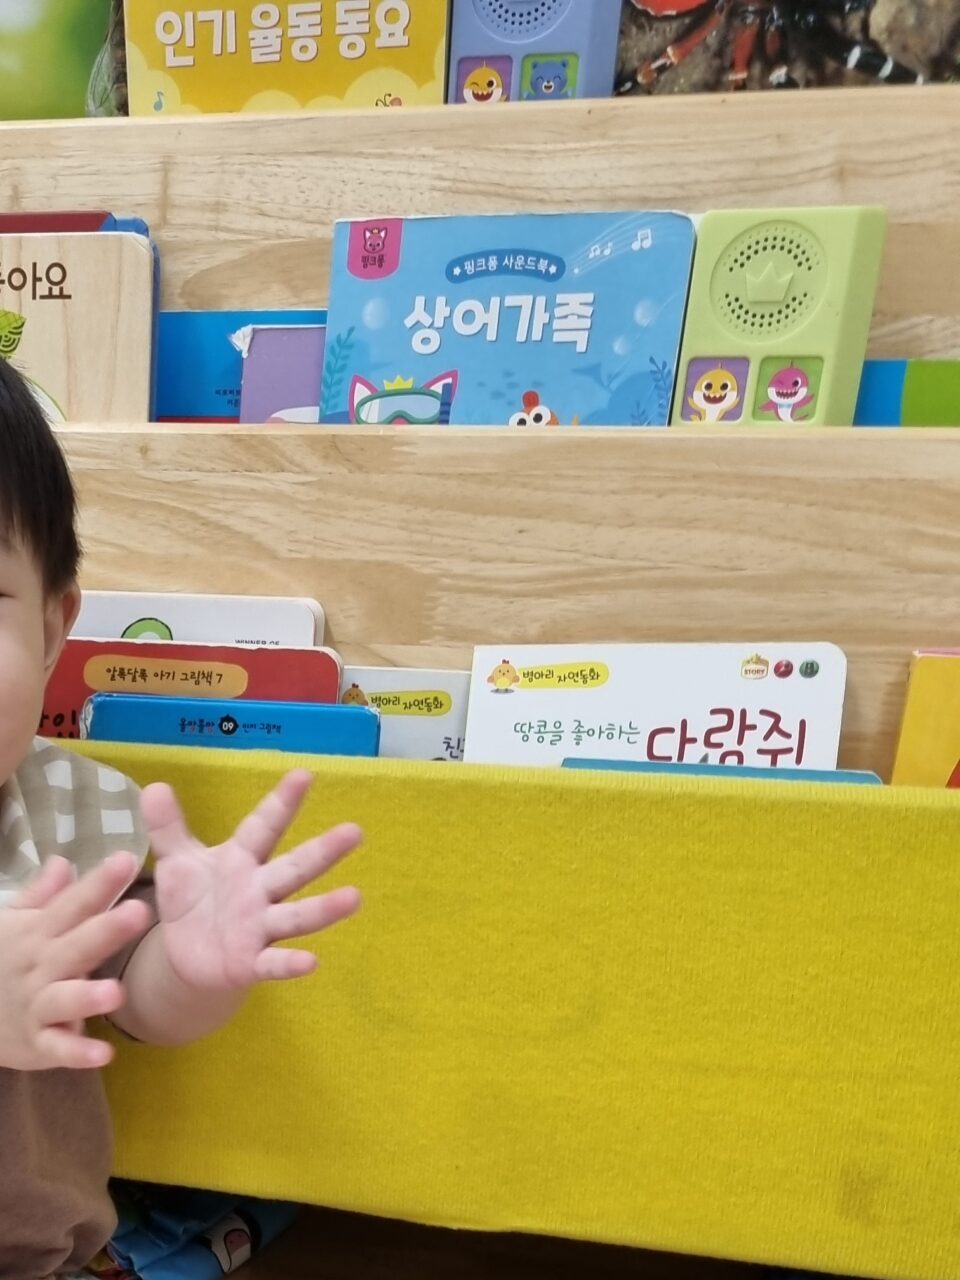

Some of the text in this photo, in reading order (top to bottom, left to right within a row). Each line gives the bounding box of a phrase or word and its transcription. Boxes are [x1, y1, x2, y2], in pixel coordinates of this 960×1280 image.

[155, 0, 411, 67] 인기 율동 동요
[463, 254, 549, 275] 핑크퐁 사운드북
[404, 292, 595, 355] 상어가족
[105, 666, 224, 686] 알록달록 아기 그림책 7
[522, 668, 601, 685] 병아리 자연동화
[743, 668, 766, 676] STORY
[370, 695, 445, 713] 병아리 자연동화
[222, 721, 235, 731] 09
[442, 736, 466, 759] 친
[513, 708, 807, 768] 땅콩을 좋아하는 다람쥐
